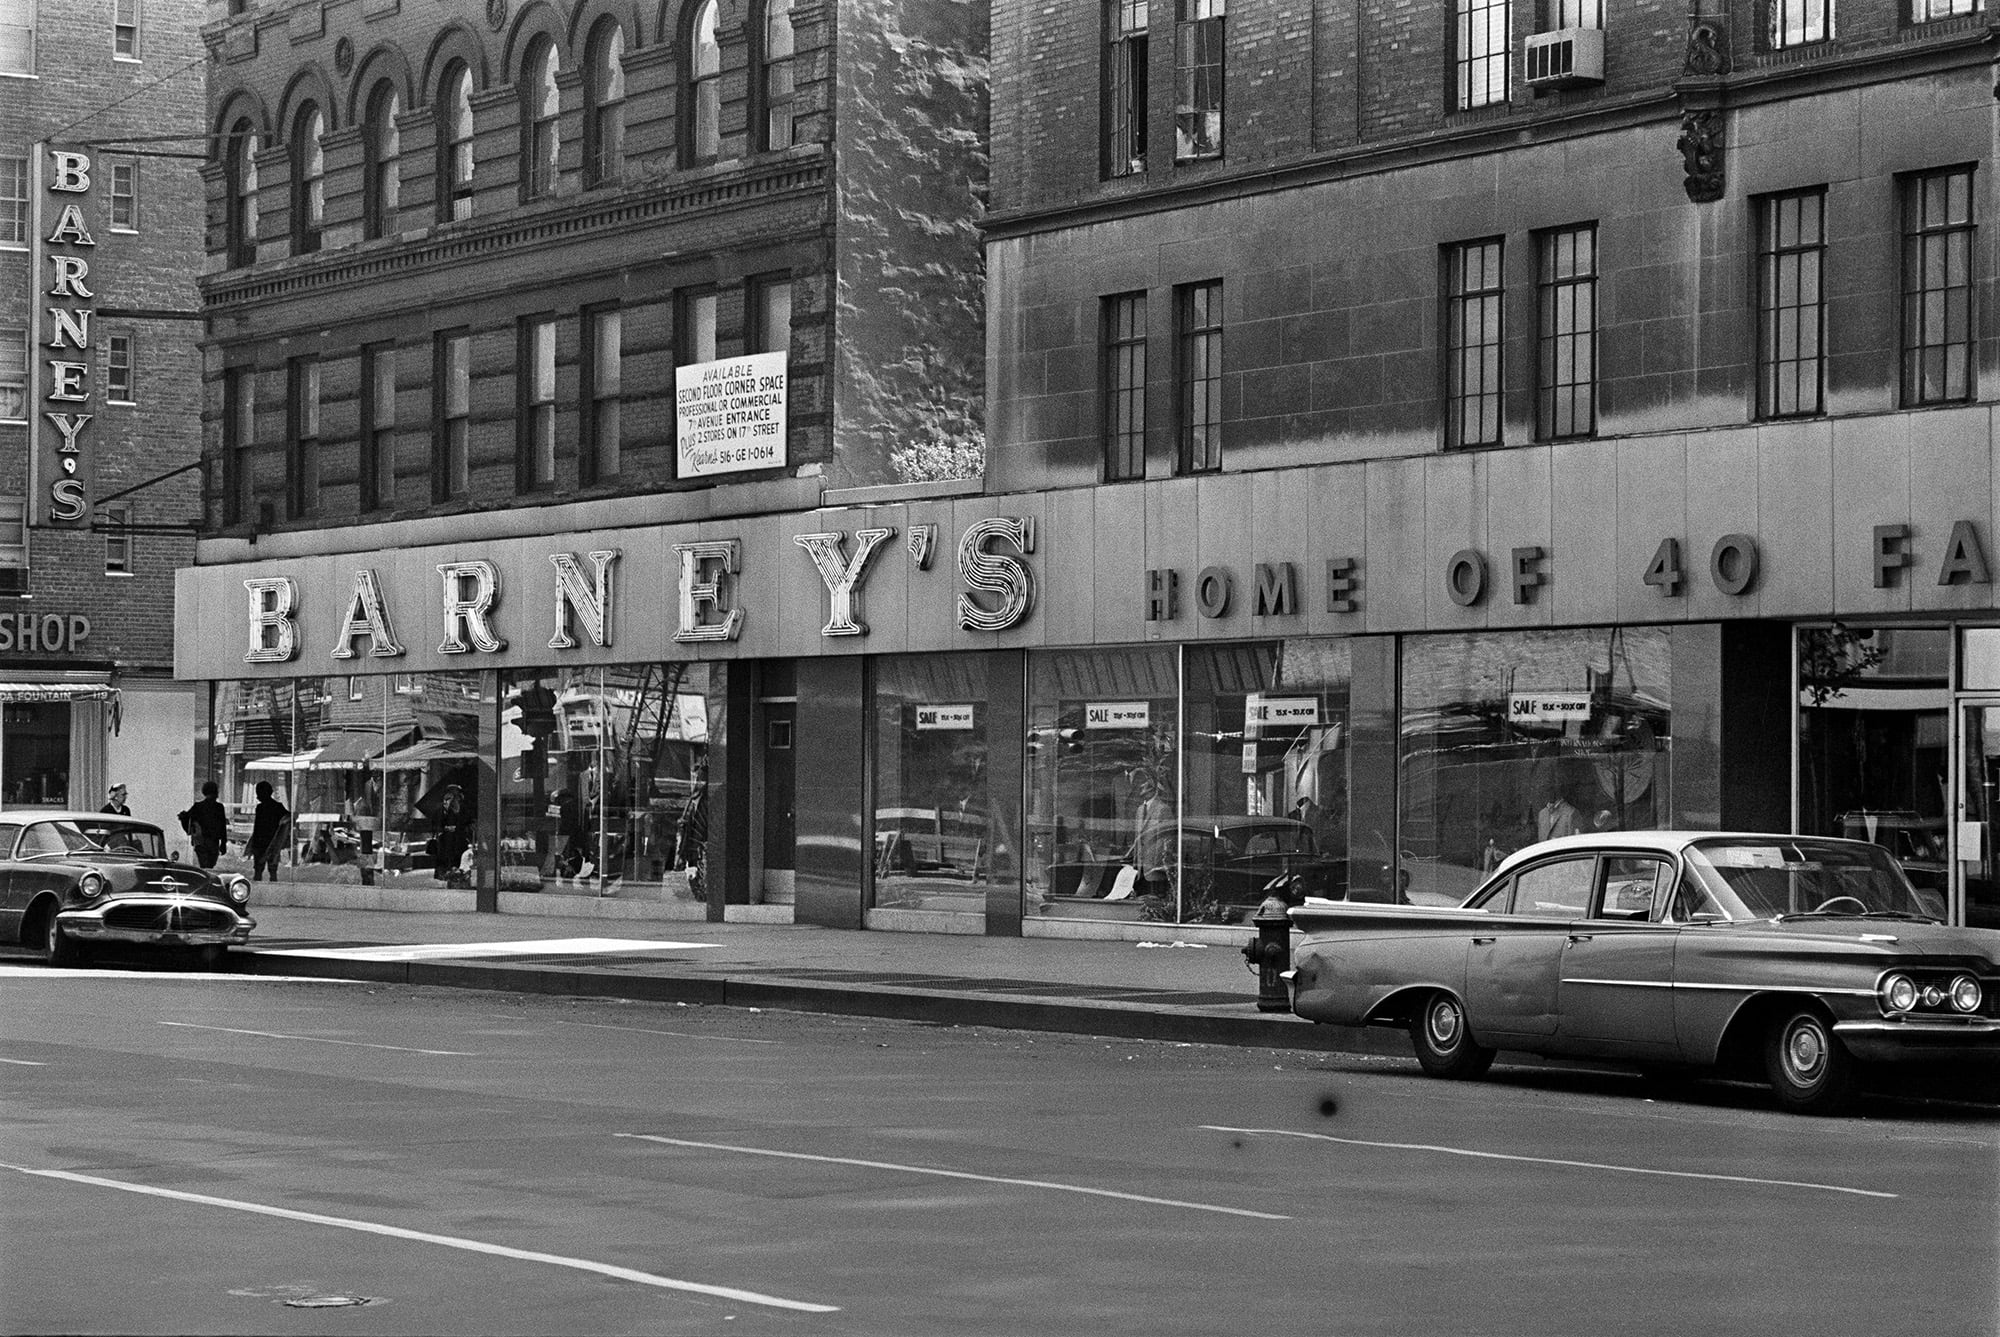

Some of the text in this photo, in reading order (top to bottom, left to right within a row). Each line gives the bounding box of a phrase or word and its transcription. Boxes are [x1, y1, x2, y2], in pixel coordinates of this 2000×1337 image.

[50, 150, 95, 520] BARNEY'S
[703, 364, 753, 382] AVAILABLE
[678, 375, 784, 404] SECOND FLOOR CORNER SPACE
[678, 393, 782, 418] PROFESSIONAL OR COMMERCIAL
[697, 414, 722, 429] AVENUE
[726, 408, 770, 425] ENTRANCE
[698, 431, 703, 443] 2
[703, 428, 725, 443] STORES
[727, 427, 737, 439] ON
[753, 422, 780, 437] STREET
[1145, 557, 1357, 621] HOME
[1446, 546, 1543, 607] OF
[1643, 533, 1760, 598] 40
[243, 515, 1036, 664] BARNEY'S
[0, 613, 91, 652] SHOP
[18, 691, 72, 701] FOUNTAIN
[919, 711, 938, 724] SALE
[1089, 709, 1109, 722] SALE
[1513, 700, 1537, 715] SALE
